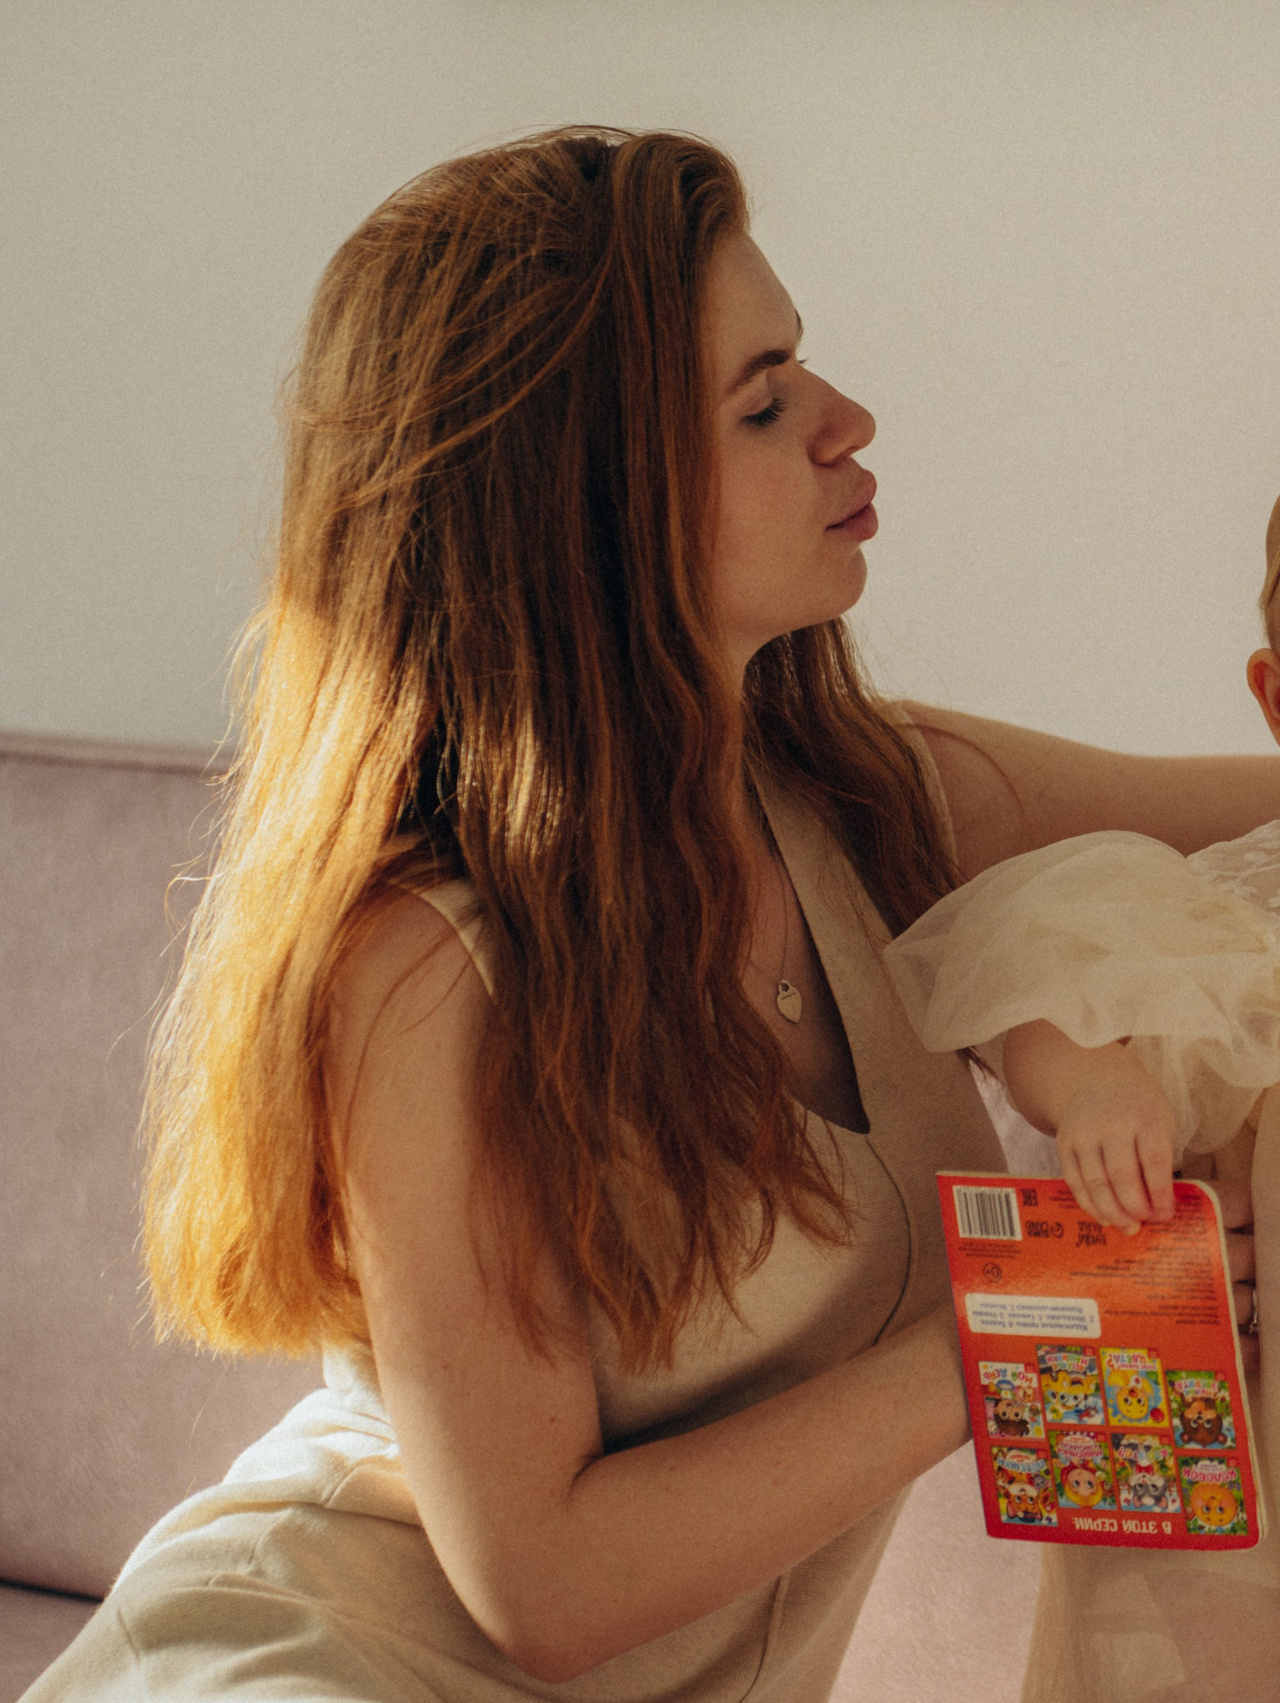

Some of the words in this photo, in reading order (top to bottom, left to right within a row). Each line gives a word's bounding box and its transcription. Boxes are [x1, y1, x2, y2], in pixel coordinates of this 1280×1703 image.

[1046, 1354, 1088, 1366] МАШИНКИ
[1106, 1353, 1146, 1369] ЦВЕТА?
[983, 1367, 1008, 1381] ДЕНЬ
[1010, 1371, 1033, 1385] МОЙ
[1176, 1380, 1217, 1390] ЗВЕРЯТА
[1118, 1446, 1145, 1461] ЭТО?
[1147, 1449, 1169, 1461] КТО
[996, 1458, 1047, 1474] ПОТЕШКИ
[1182, 1468, 1237, 1484] КОЛОБОК
[1071, 1516, 1118, 1533] СЕРИИ:
[1121, 1518, 1158, 1534] ЭТОЙ
[1163, 1520, 1172, 1534] В
